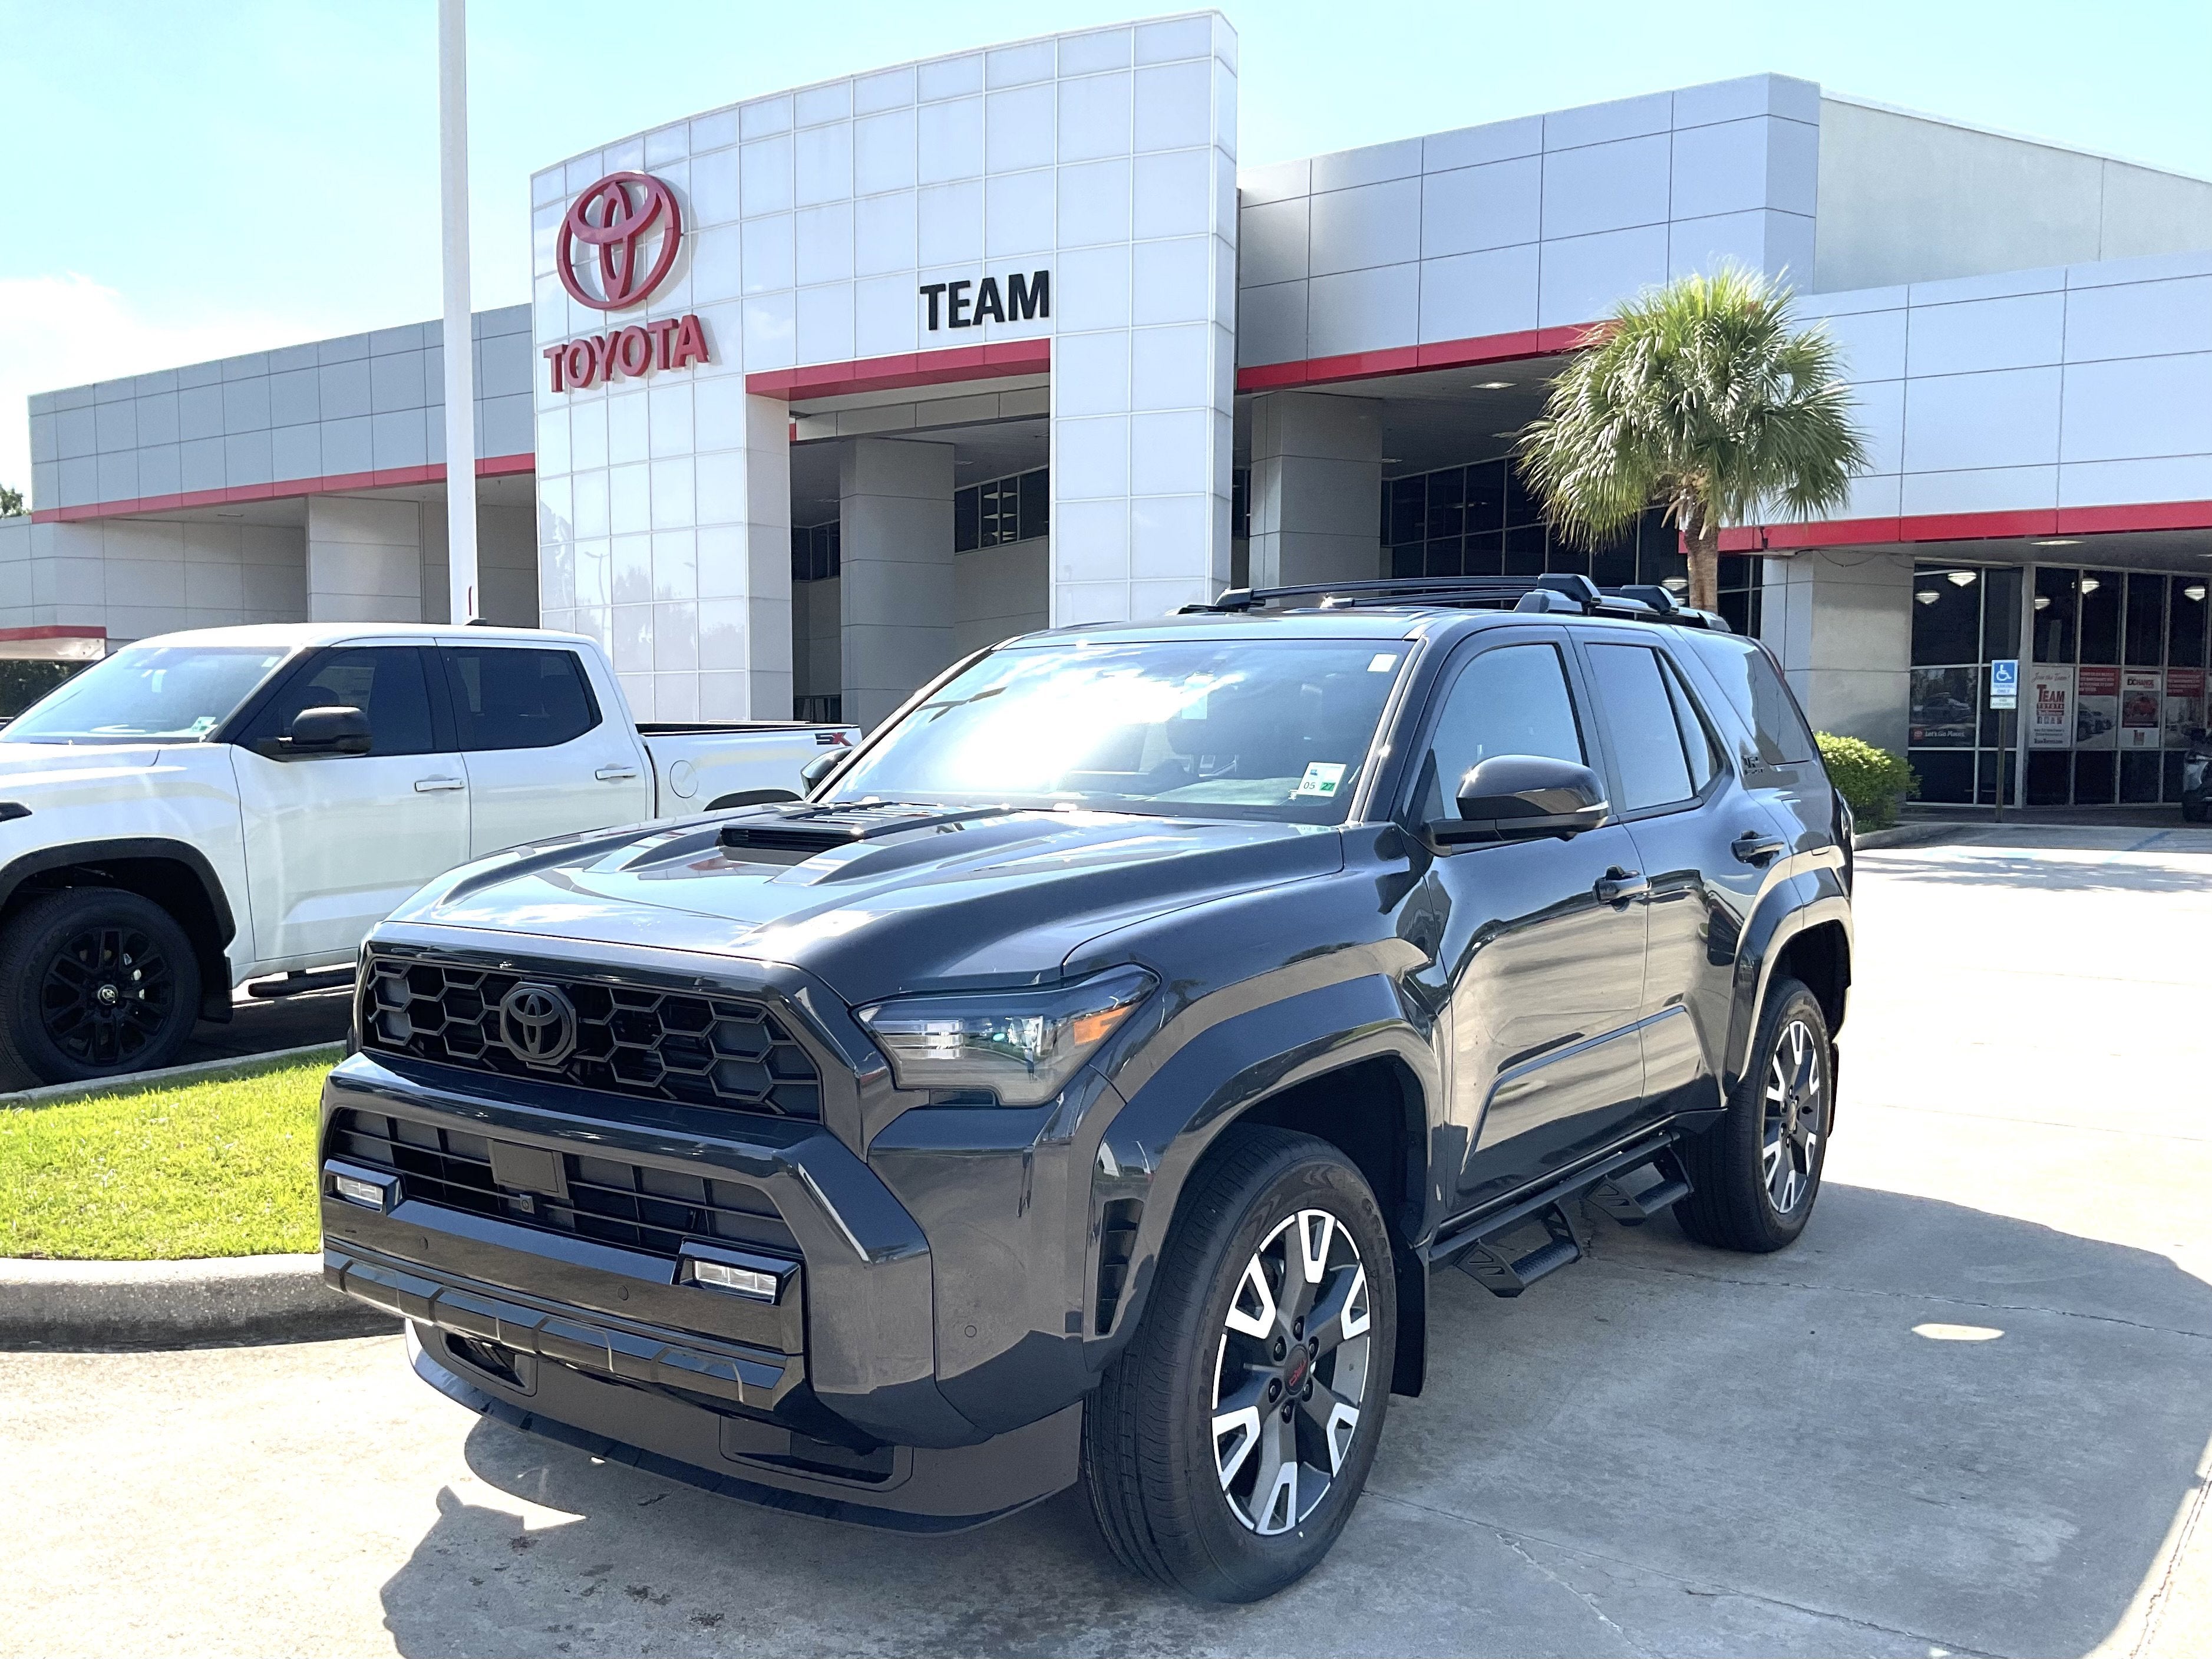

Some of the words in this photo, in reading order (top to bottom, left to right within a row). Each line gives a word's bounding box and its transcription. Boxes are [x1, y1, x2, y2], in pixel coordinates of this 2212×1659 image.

[920, 270, 1049, 331] TEAM
[543, 314, 709, 393] TOYOTA
[2037, 684, 2065, 702] TEAM
[1303, 781, 1316, 790] 05
[1320, 782, 1336, 791] 27
